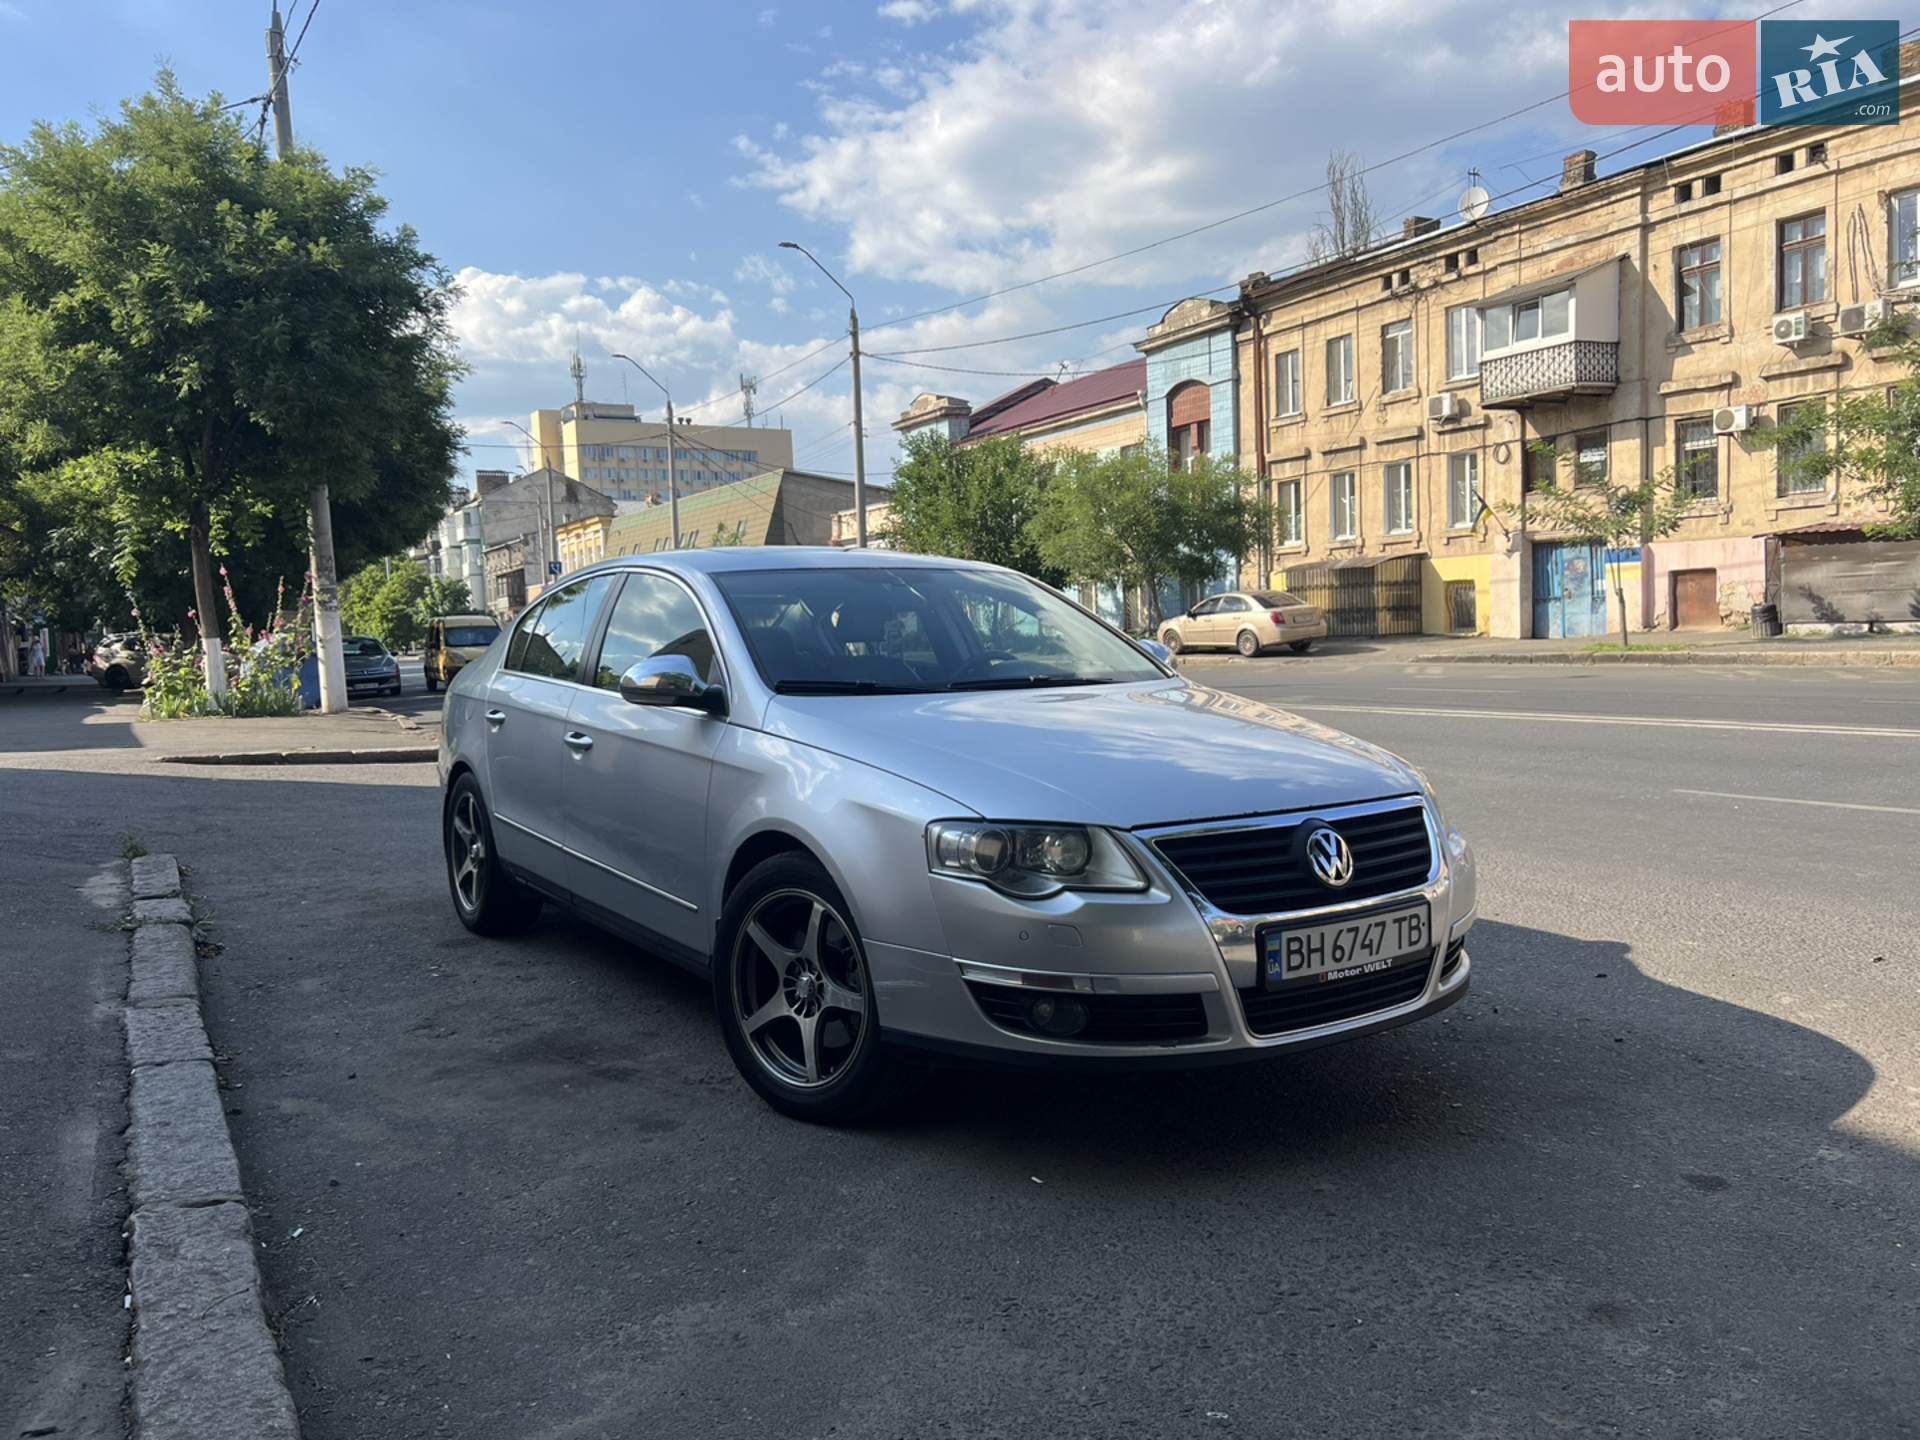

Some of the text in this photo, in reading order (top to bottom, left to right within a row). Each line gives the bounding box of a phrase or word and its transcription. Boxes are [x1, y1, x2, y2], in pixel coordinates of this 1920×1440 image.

[1286, 913, 1422, 972] BH 6747 TB
[1267, 962, 1281, 974] UA
[1327, 958, 1393, 981] Motor WELT
